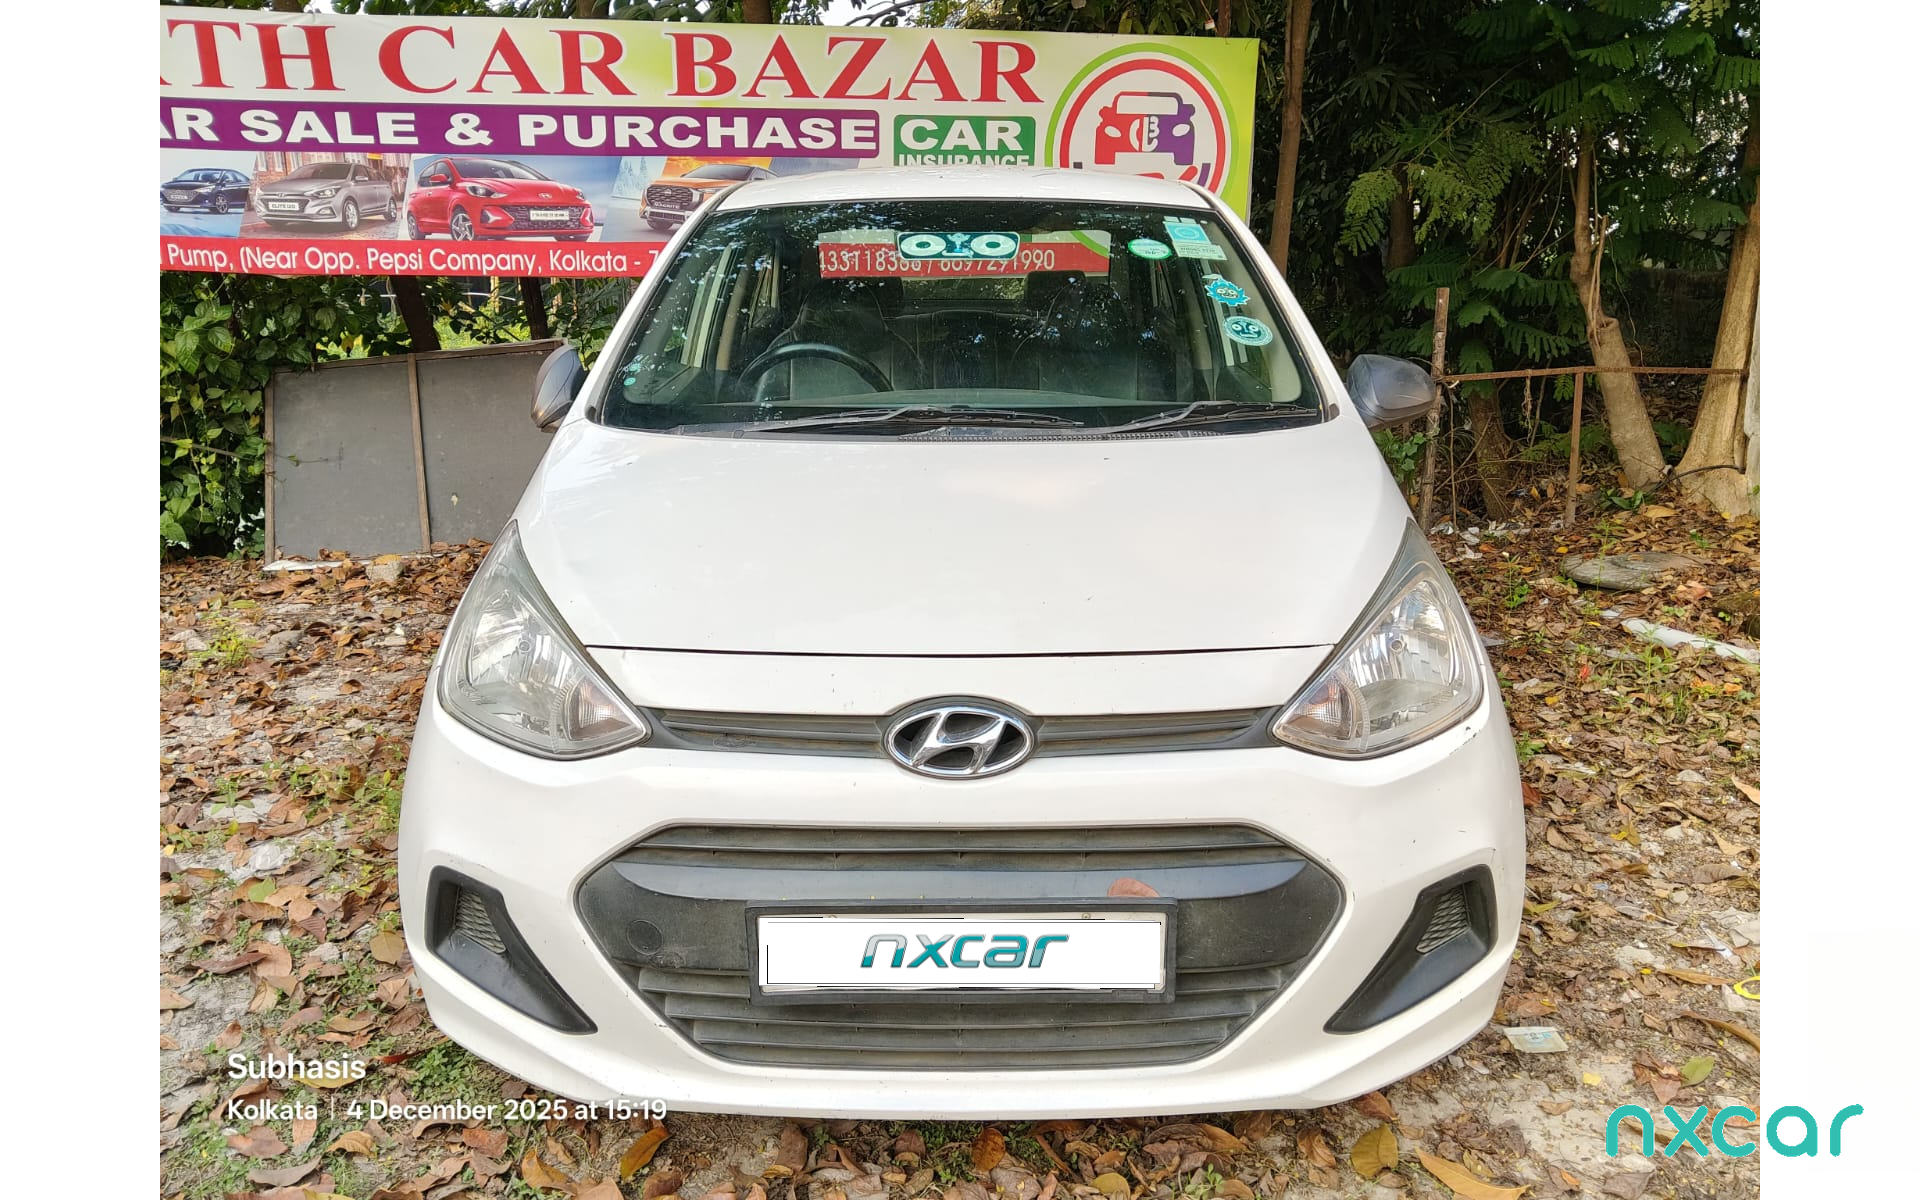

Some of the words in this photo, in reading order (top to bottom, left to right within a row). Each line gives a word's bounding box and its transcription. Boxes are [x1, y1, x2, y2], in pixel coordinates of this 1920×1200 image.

[160, 19, 346, 91] TH
[378, 25, 637, 96] CAR
[664, 33, 1044, 103] BAZAR
[239, 109, 419, 145] SALE
[444, 112, 494, 146] &
[518, 114, 876, 150] PURCHASE
[900, 118, 1024, 151] CAR
[167, 243, 234, 271] Pump,
[240, 246, 298, 273] (Near
[304, 246, 361, 275] Opp.
[366, 247, 423, 275] Pepsi
[429, 247, 542, 275] Company,
[549, 249, 628, 272] Kolkata
